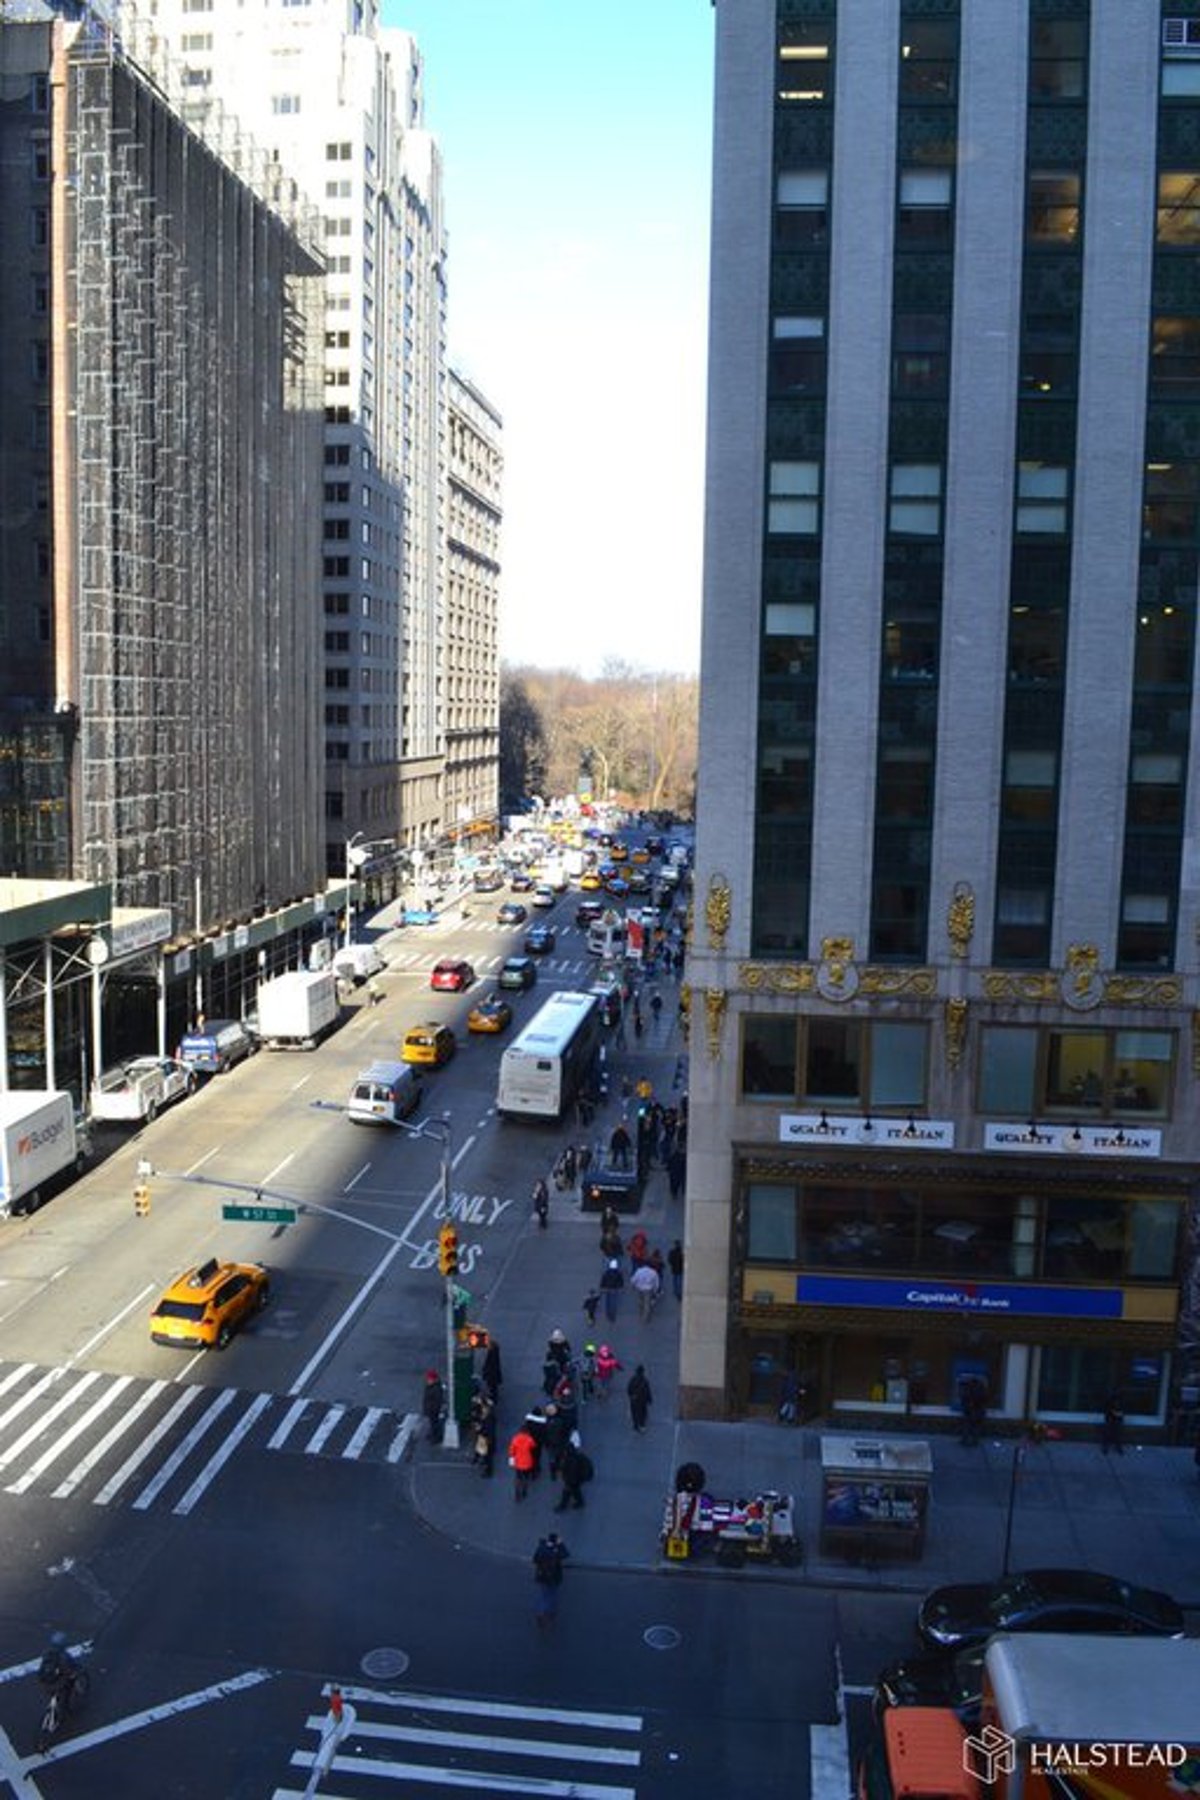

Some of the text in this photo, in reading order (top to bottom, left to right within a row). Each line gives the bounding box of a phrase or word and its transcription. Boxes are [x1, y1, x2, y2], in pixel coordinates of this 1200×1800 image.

[789, 1124, 944, 1140] QUALITY ITALIAN
[994, 1132, 1151, 1149] QUALITY ITALIAN
[409, 1240, 482, 1274] BS
